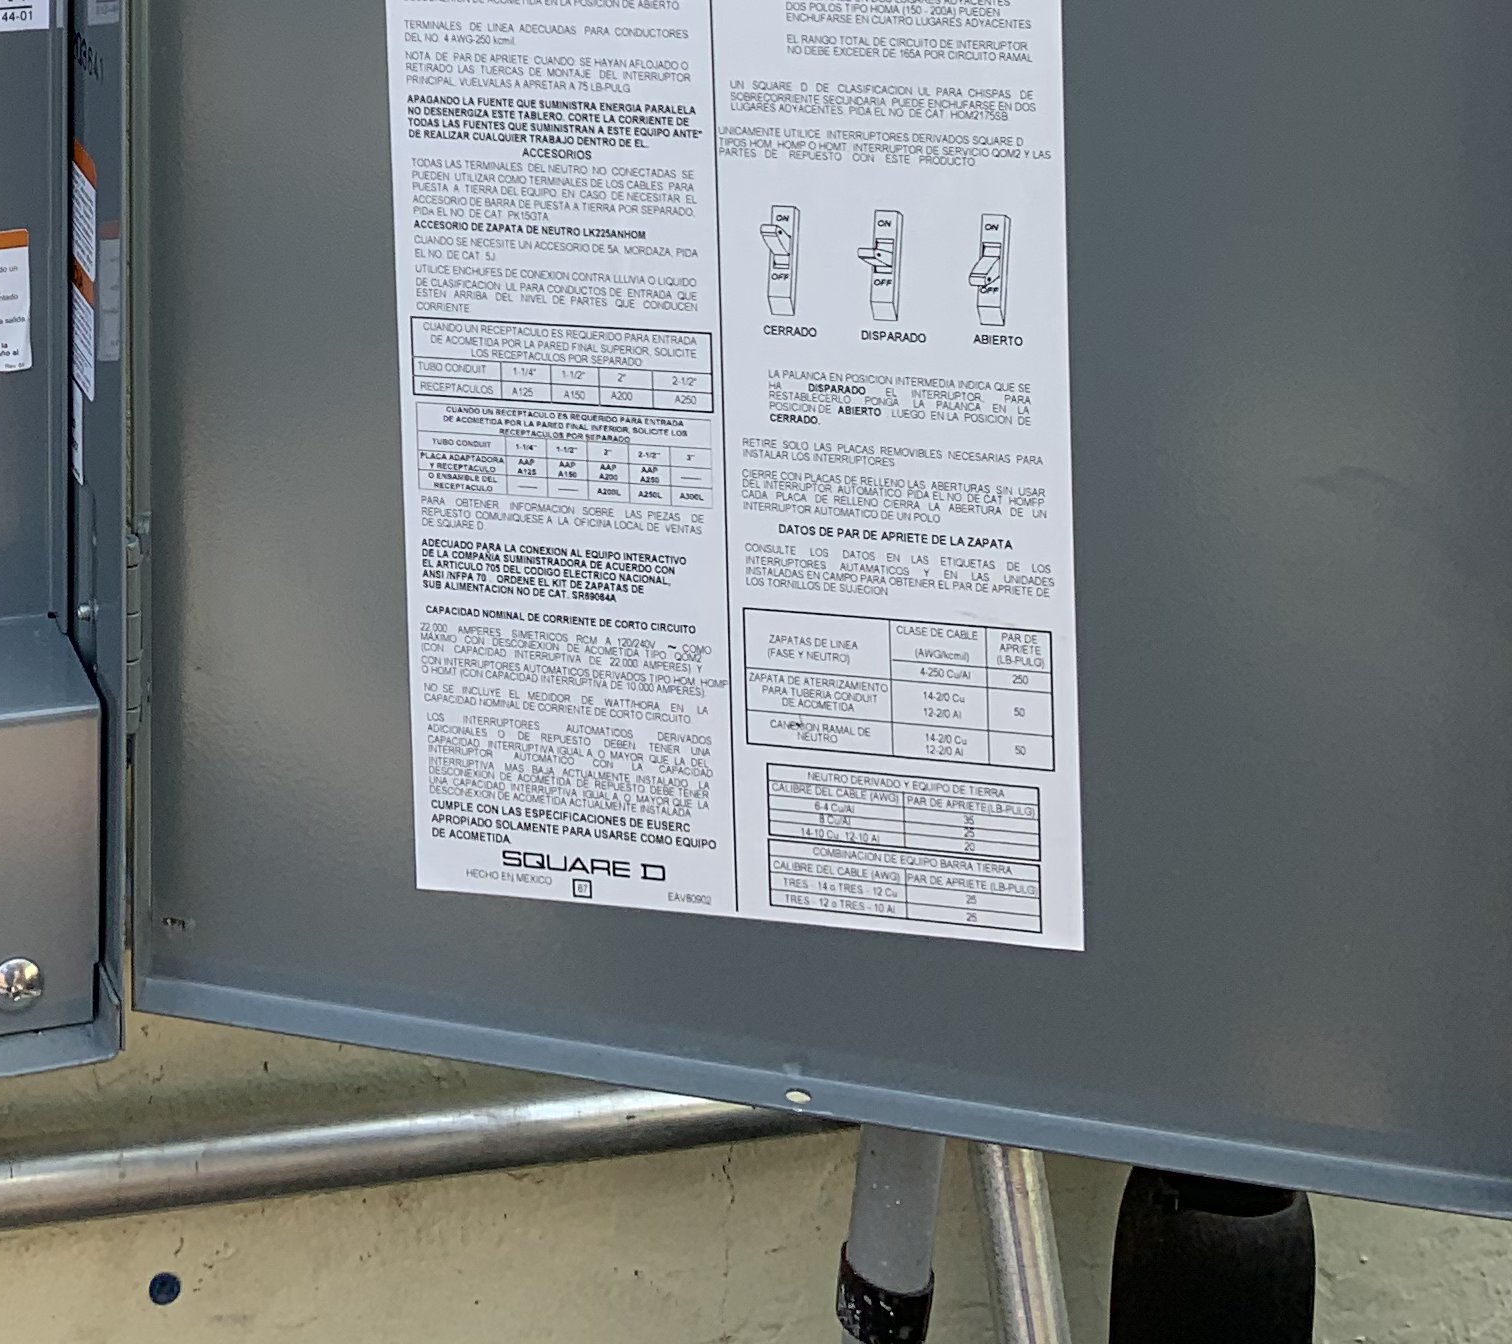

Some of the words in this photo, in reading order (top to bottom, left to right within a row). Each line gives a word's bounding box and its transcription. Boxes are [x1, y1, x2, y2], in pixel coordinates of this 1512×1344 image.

[763, 324, 818, 338] CERRADO
[861, 329, 927, 343] DISPARADO
[973, 334, 1024, 347] ABIERTO
[778, 523, 816, 536] DATOS
[818, 526, 834, 538] DE
[836, 527, 860, 539] PAR
[862, 529, 878, 541] DE
[880, 531, 929, 545] APRIETE
[931, 534, 947, 546] DE
[949, 535, 965, 547] LA
[967, 536, 1013, 550] ZAPATA
[502, 849, 631, 879] SQUARE
[640, 863, 666, 882] D
